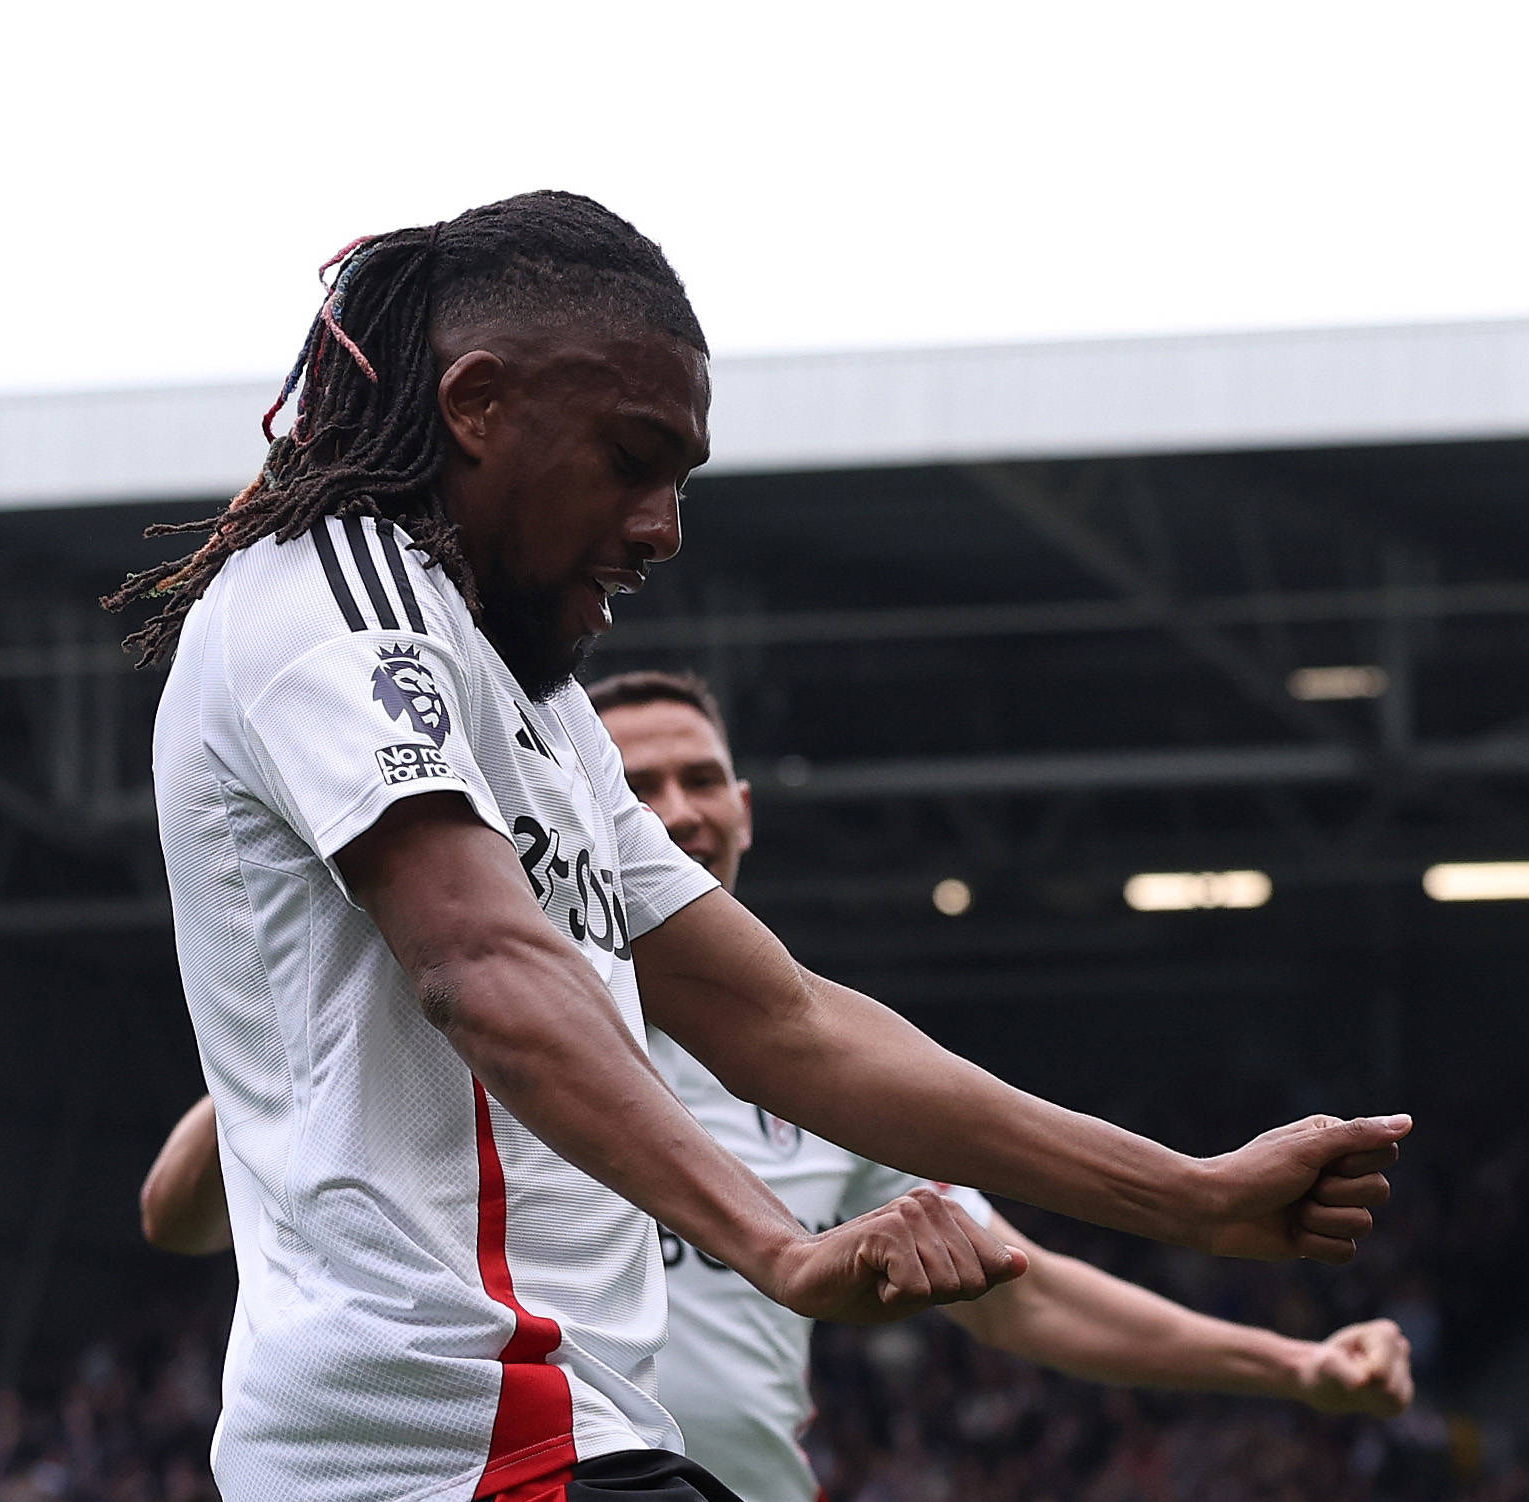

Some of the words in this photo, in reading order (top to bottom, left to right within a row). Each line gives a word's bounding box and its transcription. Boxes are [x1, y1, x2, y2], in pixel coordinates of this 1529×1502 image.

[376, 746, 417, 770] No
[419, 747, 448, 763] ro
[382, 764, 421, 785] for
